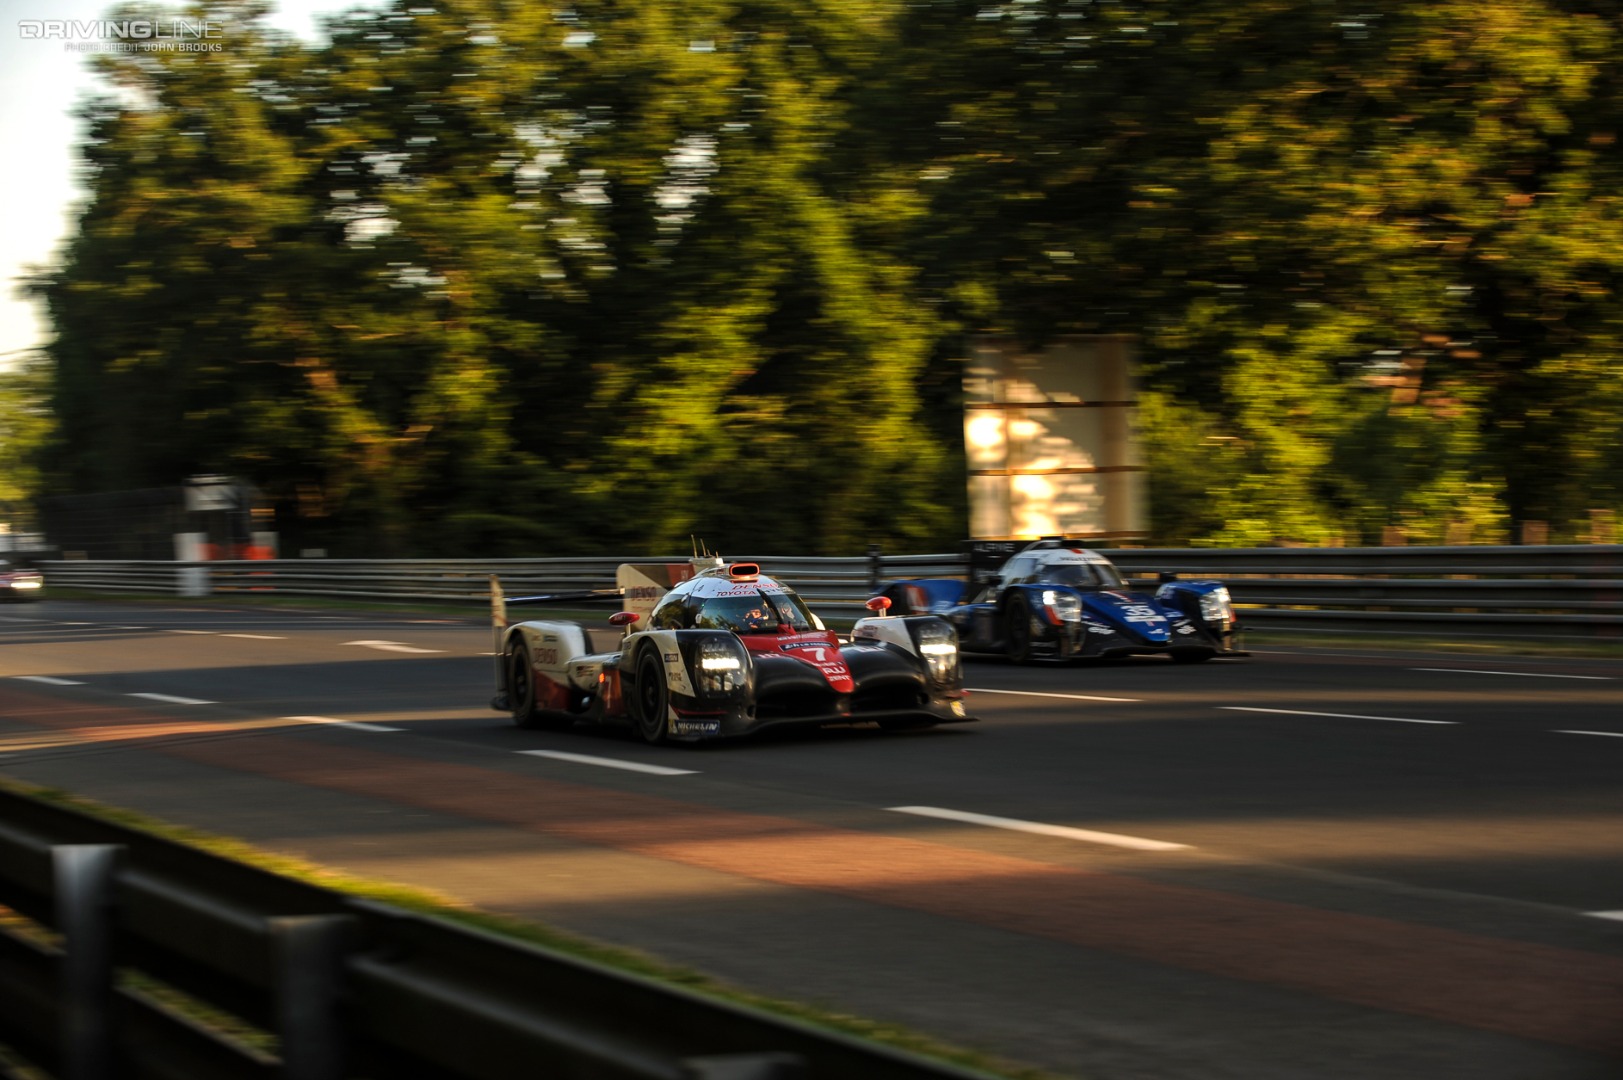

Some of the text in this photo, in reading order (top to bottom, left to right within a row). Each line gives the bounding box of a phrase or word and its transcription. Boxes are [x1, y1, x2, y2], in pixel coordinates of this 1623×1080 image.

[1120, 605, 1156, 616] 35
[802, 647, 826, 661] 7
[677, 722, 718, 730] MICHELIN
